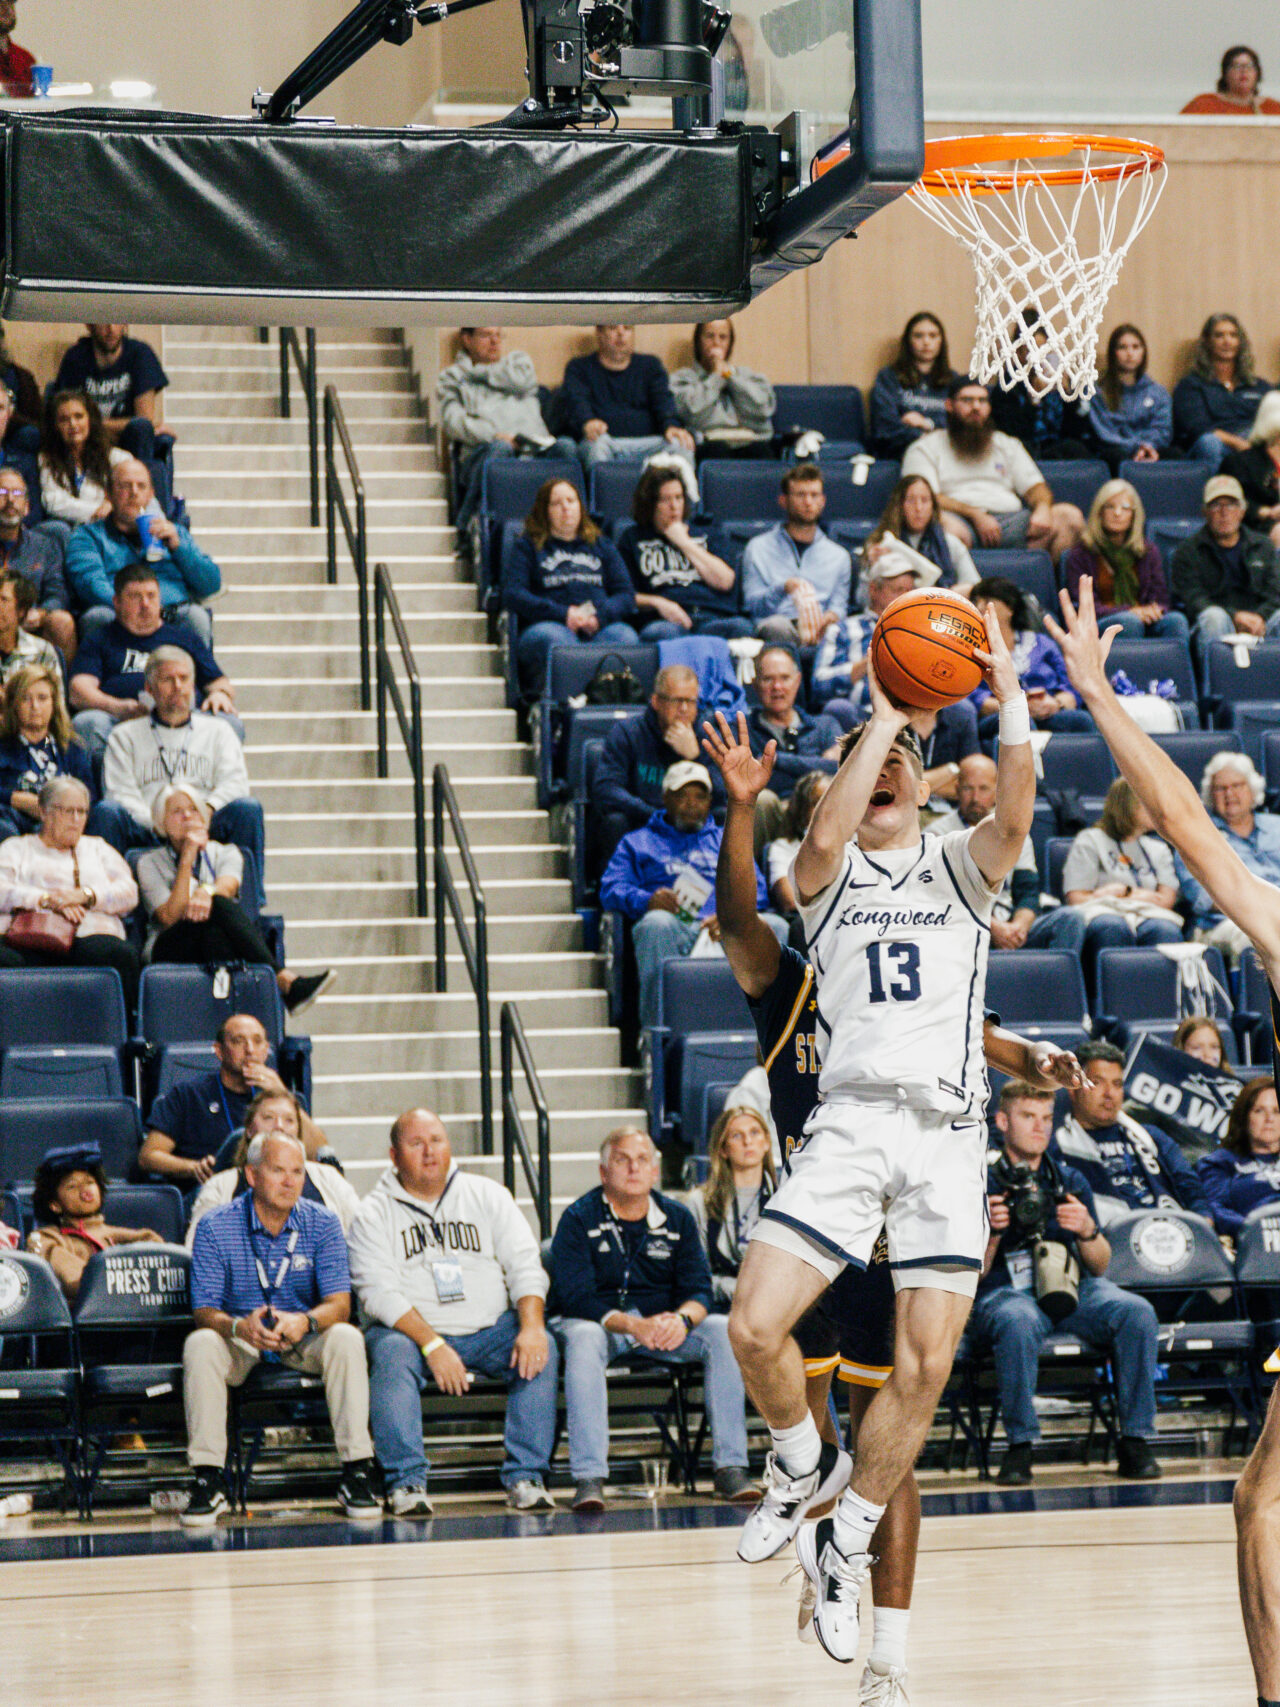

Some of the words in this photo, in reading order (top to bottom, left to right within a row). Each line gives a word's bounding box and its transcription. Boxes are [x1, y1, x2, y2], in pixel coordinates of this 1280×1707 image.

[928, 610, 987, 645] LEGACY
[836, 904, 952, 936] Longwood
[866, 941, 921, 1004] 13
[1130, 1072, 1183, 1116] GO
[105, 1256, 133, 1270] NORTH
[138, 1255, 170, 1269] STREET
[106, 1268, 150, 1295] PRESS
[157, 1267, 185, 1293] CLUB
